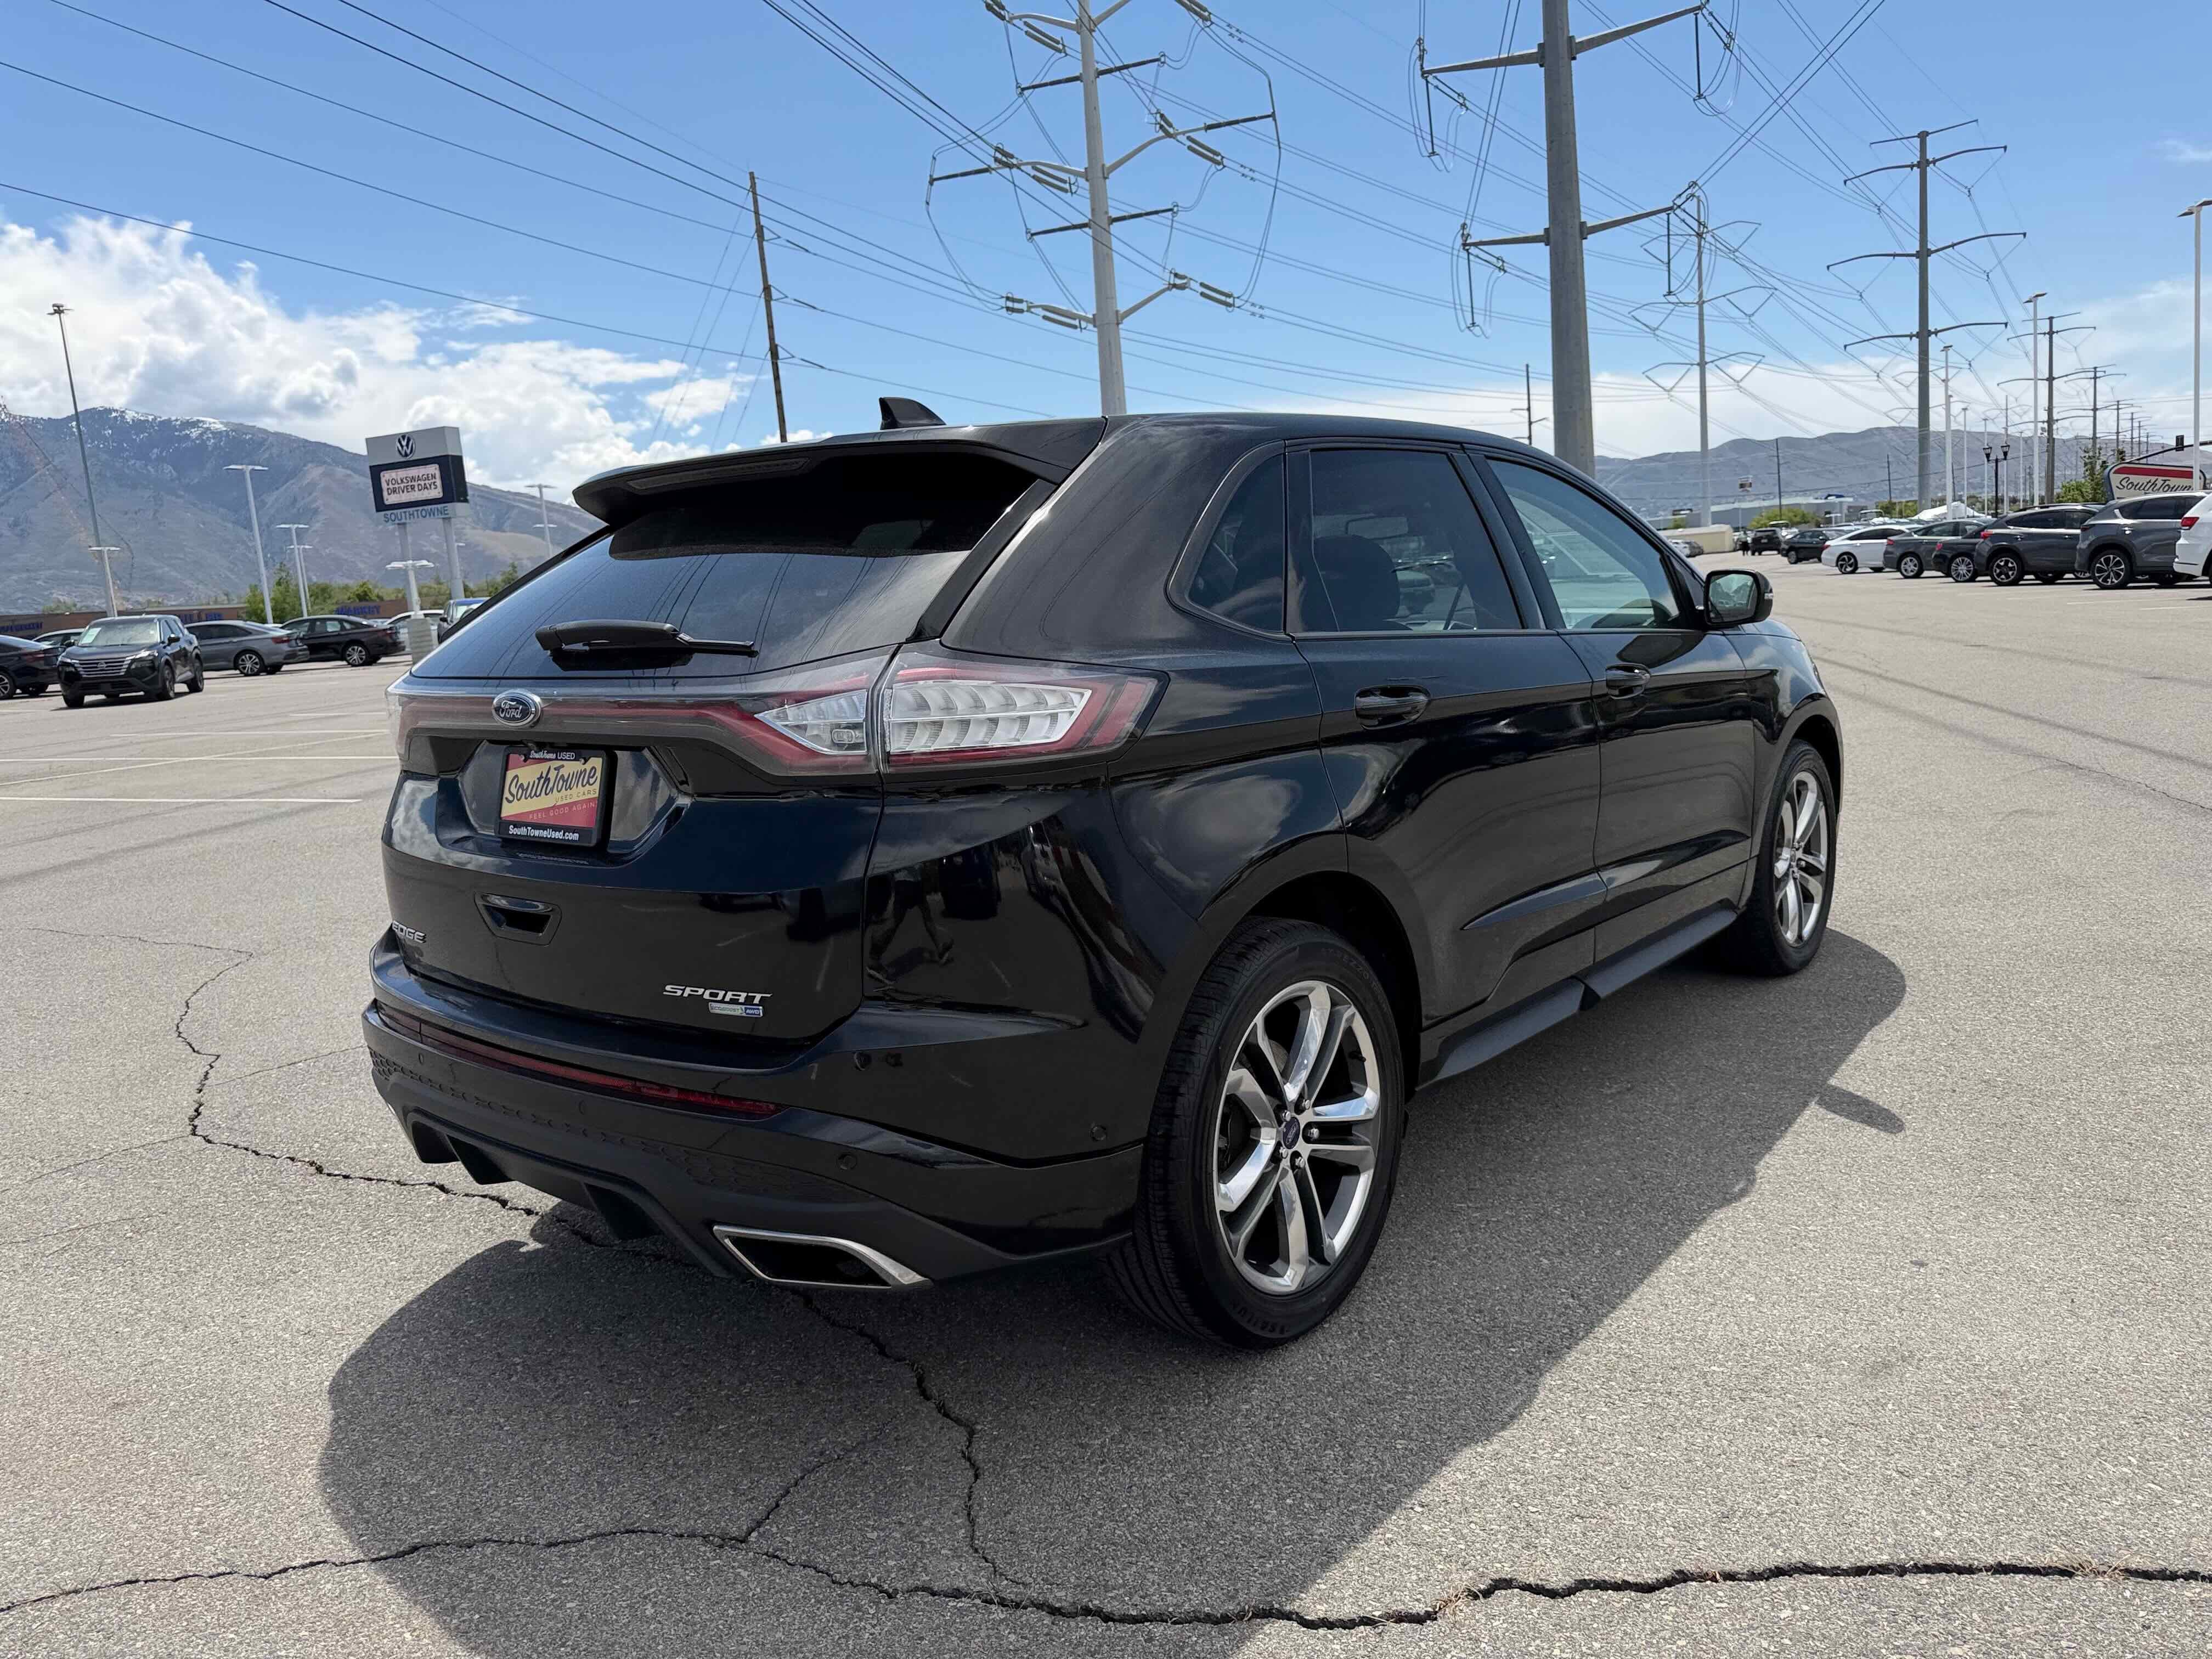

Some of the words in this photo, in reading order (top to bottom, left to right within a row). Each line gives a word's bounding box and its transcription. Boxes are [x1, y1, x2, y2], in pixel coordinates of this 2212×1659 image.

[385, 472, 437, 486] VOLKSWAGEN
[2116, 476, 2194, 493] SouthTown
[387, 484, 416, 495] DRIVER
[417, 482, 438, 492] DAYS
[384, 505, 449, 523] SOUTHTOWNE
[499, 700, 522, 718] Ford
[557, 752, 575, 760] USED
[505, 764, 598, 804] SouthTowne
[555, 794, 573, 803] USED
[577, 788, 597, 798] CARS
[549, 807, 569, 816] GOOD
[509, 825, 579, 840] SouthTowneUsed.com
[392, 921, 426, 944] EDGE
[663, 985, 773, 1004] SPORT
